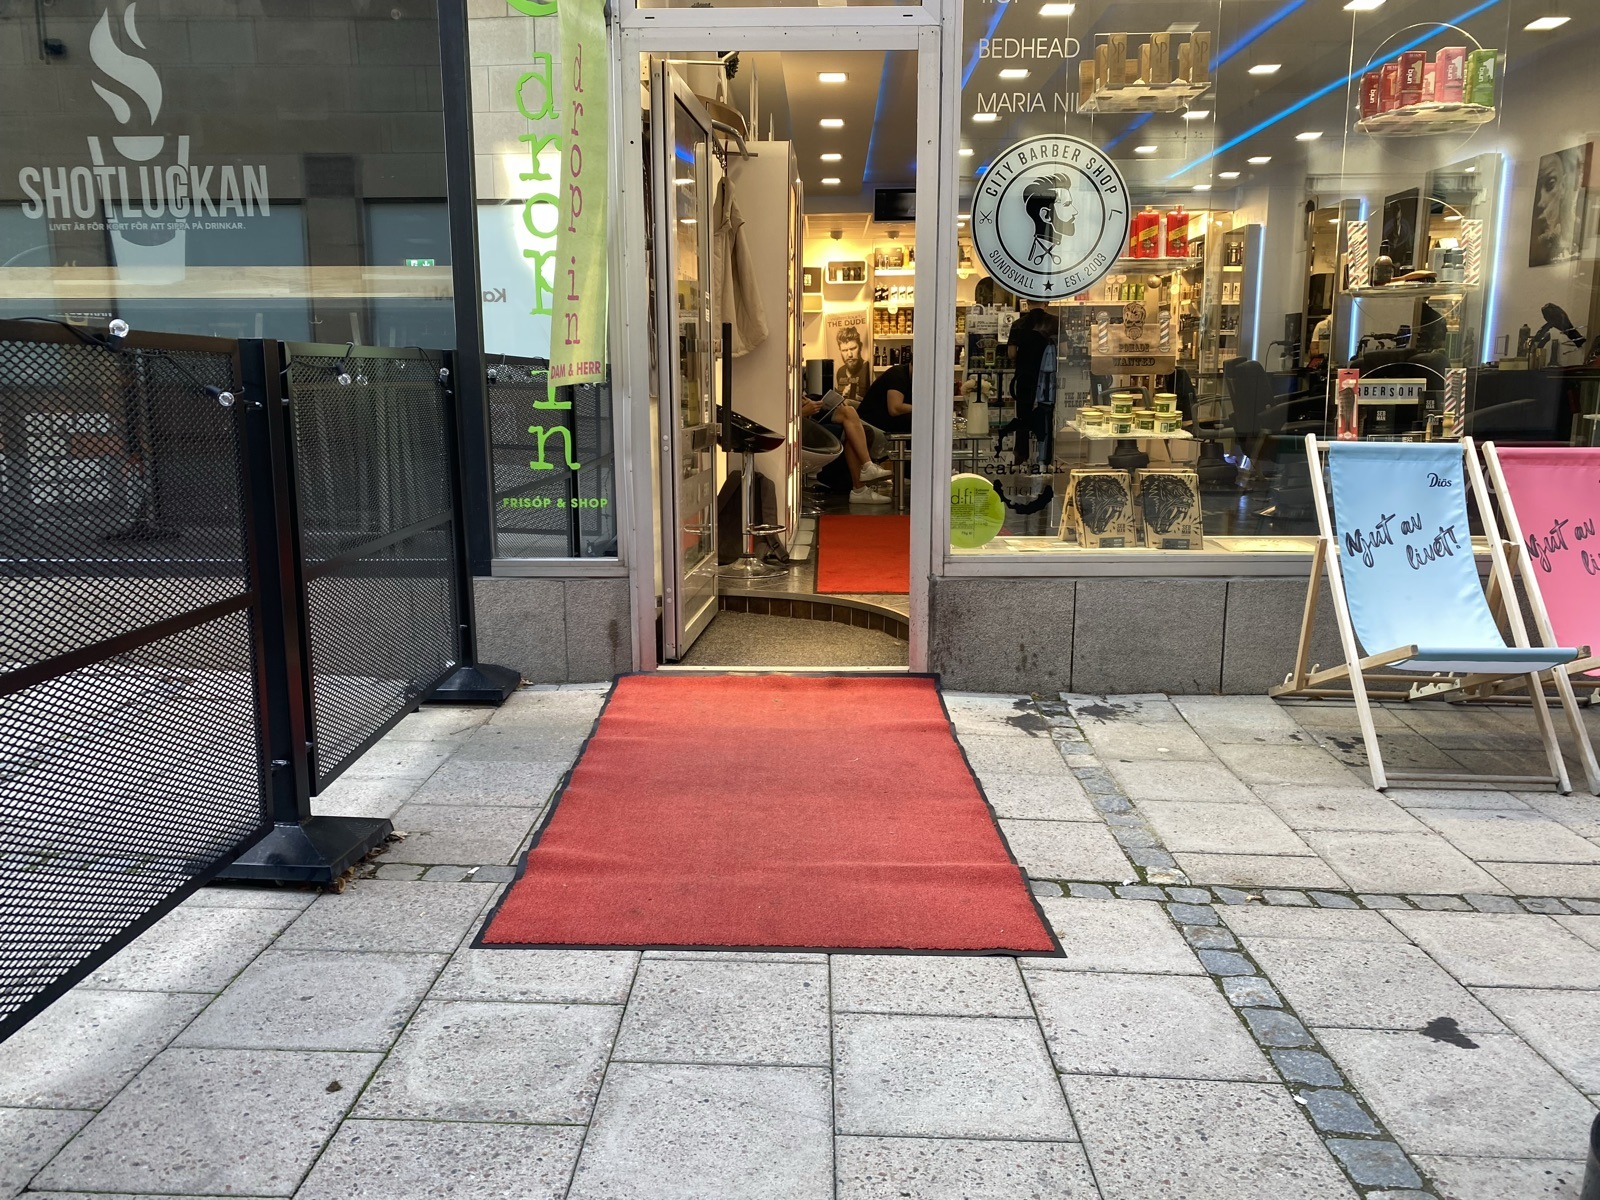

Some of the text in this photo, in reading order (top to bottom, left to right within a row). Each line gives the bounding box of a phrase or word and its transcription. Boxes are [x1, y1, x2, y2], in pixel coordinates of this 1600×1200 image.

[979, 37, 1081, 59] BEDHEAD
[977, 92, 1047, 113] MARIA
[985, 143, 1119, 198] CITY BARBER SHOP
[18, 164, 271, 220] SHOTLUCKAN
[48, 220, 247, 232] LIVET ÄR FÖR KORT FÖR ATT SIPPA PÅ DRINKAR.
[988, 249, 1036, 291] SUNDSVALL
[1064, 251, 1109, 289] EST. 2003
[827, 318, 866, 328] THE DUDE
[1118, 343, 1150, 353] POMADE
[550, 360, 602, 380] DAM & HERR
[1112, 357, 1156, 367] WANTED
[984, 460, 1066, 476] catwalk
[1426, 472, 1453, 488] Diös
[1006, 486, 1032, 497] TIGI
[557, 498, 567, 509] &
[570, 497, 609, 509] SHOP
[1400, 512, 1423, 536] av
[1573, 518, 1597, 541] av
[1405, 525, 1463, 571] livet!
